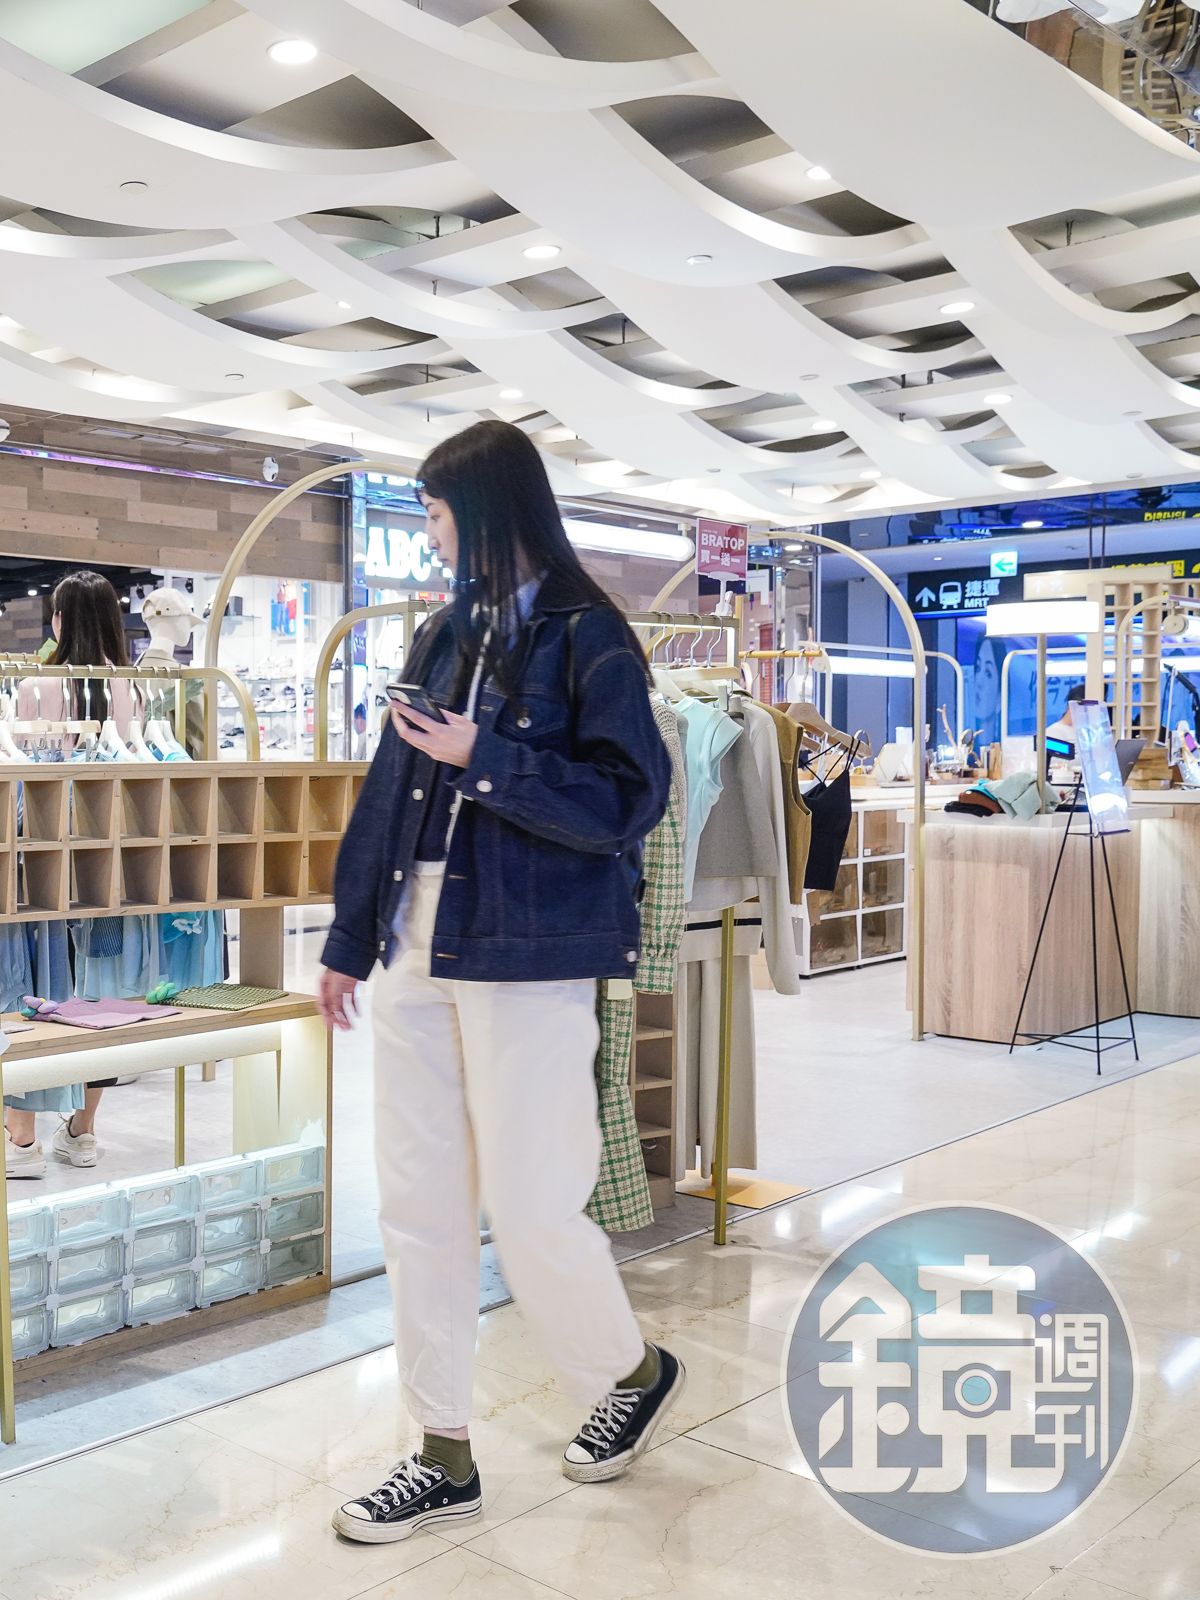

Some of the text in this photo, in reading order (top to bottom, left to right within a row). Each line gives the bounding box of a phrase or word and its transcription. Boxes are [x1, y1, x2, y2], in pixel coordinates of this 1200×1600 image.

[701, 532, 745, 551] BRATOP
[965, 579, 1000, 598] 捷運
[964, 597, 990, 609] MRT
